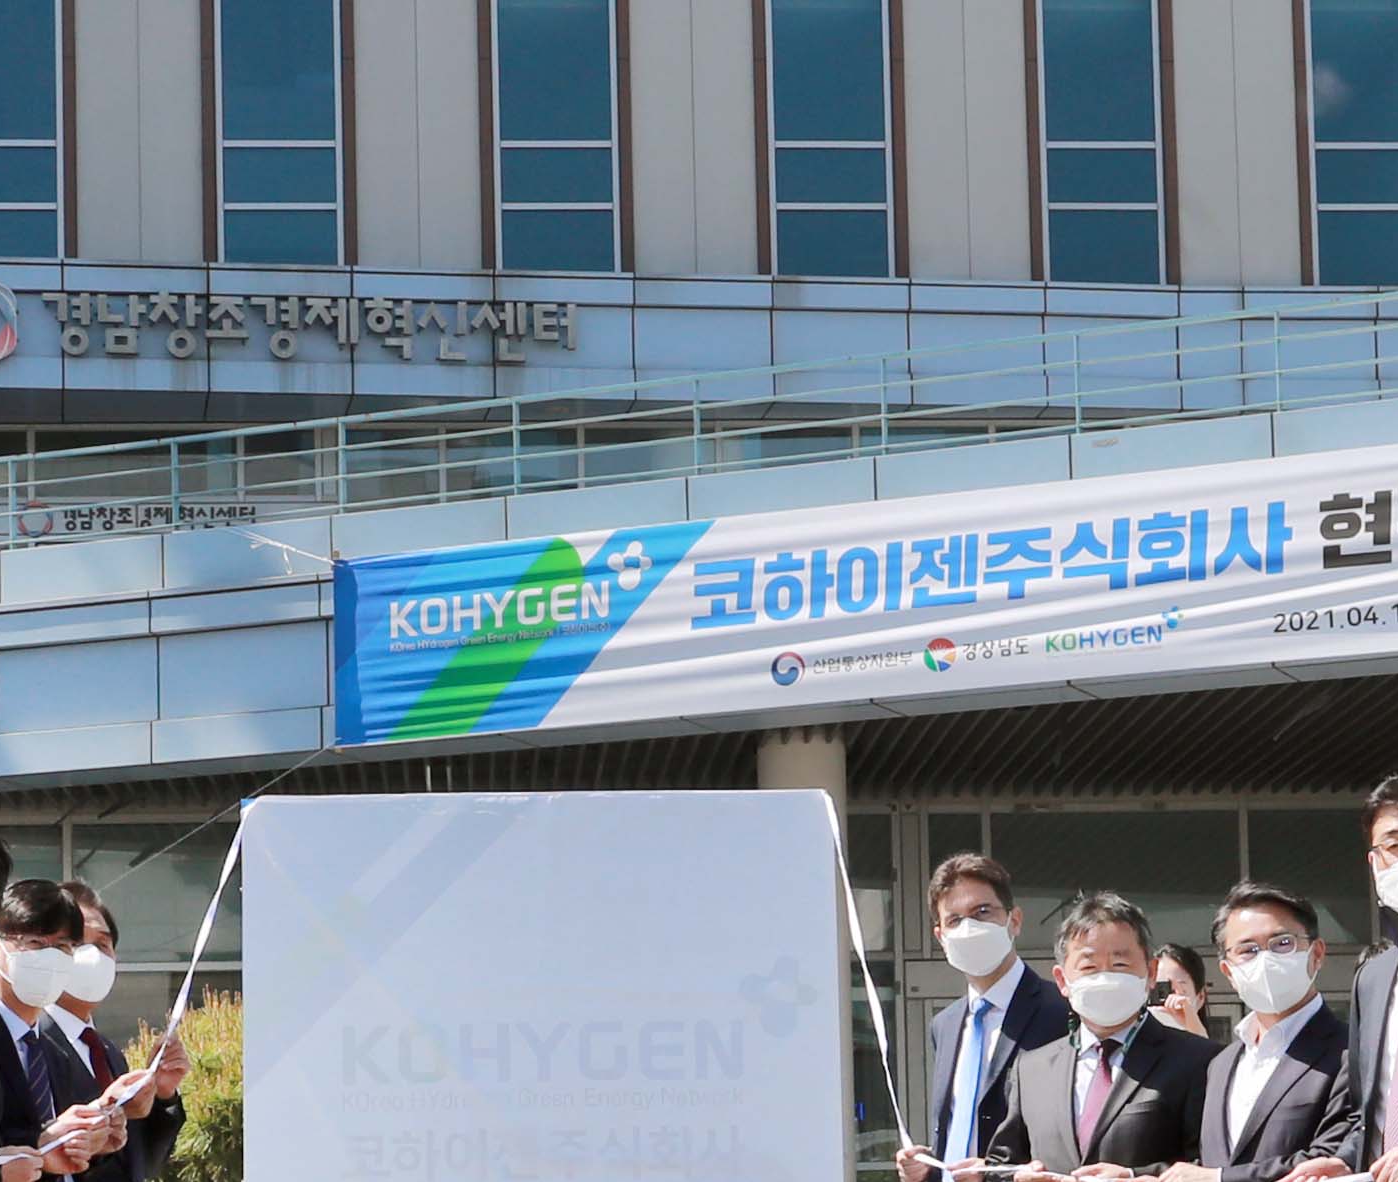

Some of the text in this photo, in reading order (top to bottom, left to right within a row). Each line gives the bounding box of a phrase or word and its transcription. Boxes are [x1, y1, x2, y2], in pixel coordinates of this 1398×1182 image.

[42, 291, 577, 362] 경남창조경제혁신센터
[691, 501, 1293, 629] 코하이젠주식회사
[389, 581, 610, 638] KOHYGEN
[813, 650, 914, 675] 산업통상자원부
[962, 637, 1030, 661] 경상남도
[1045, 624, 1163, 653] KOHYGEN
[341, 1018, 745, 1086] KOHYGEN
